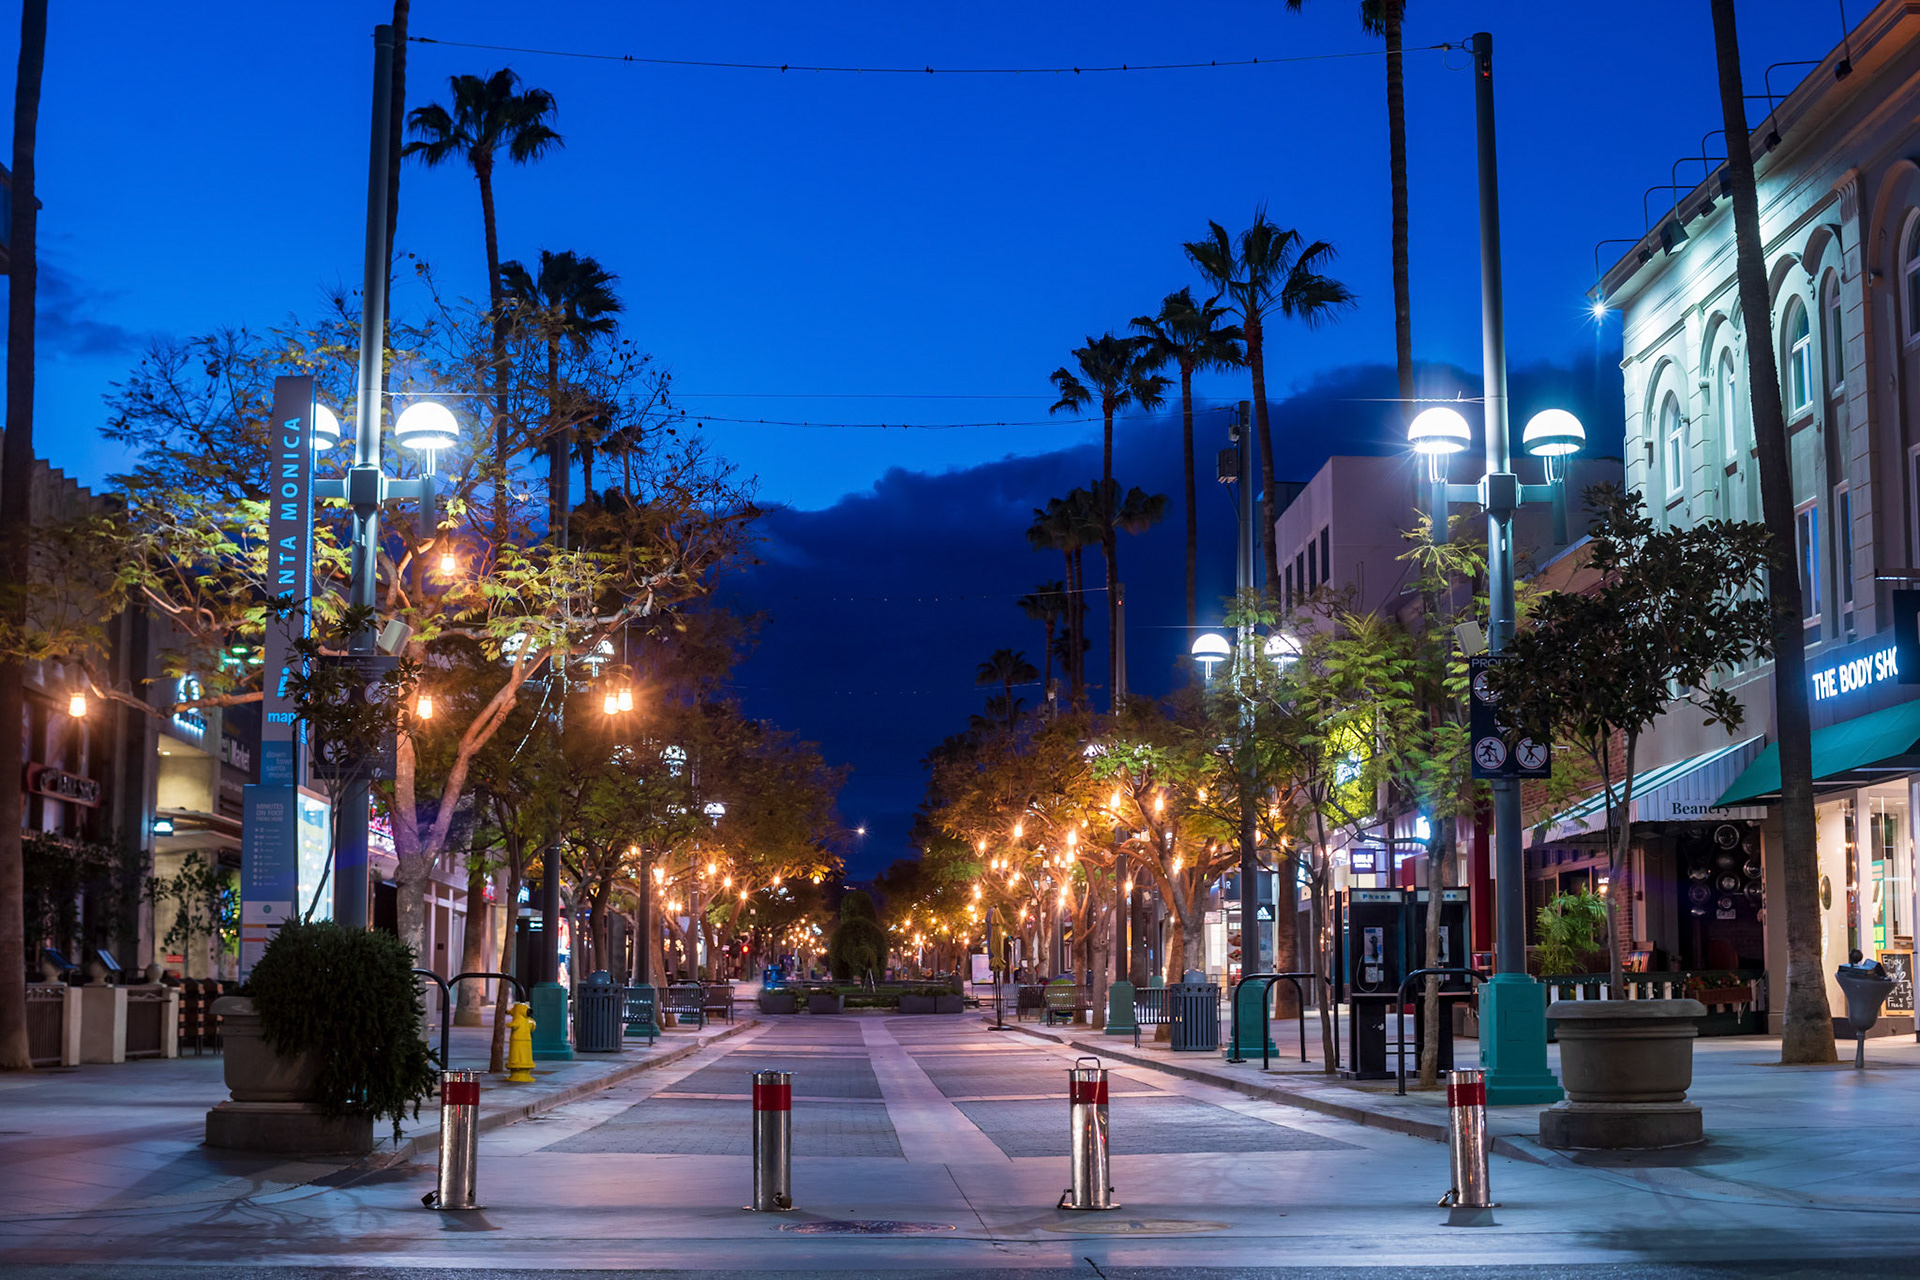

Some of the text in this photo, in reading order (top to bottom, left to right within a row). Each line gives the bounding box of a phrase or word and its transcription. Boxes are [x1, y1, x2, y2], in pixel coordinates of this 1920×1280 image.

[281, 417, 300, 520] MONICA
[1812, 667, 1838, 701] THE
[1839, 655, 1873, 693] BODY
[267, 712, 297, 726] map
[1672, 802, 1730, 817] Beanery
[1883, 955, 1904, 970] Enjoy
